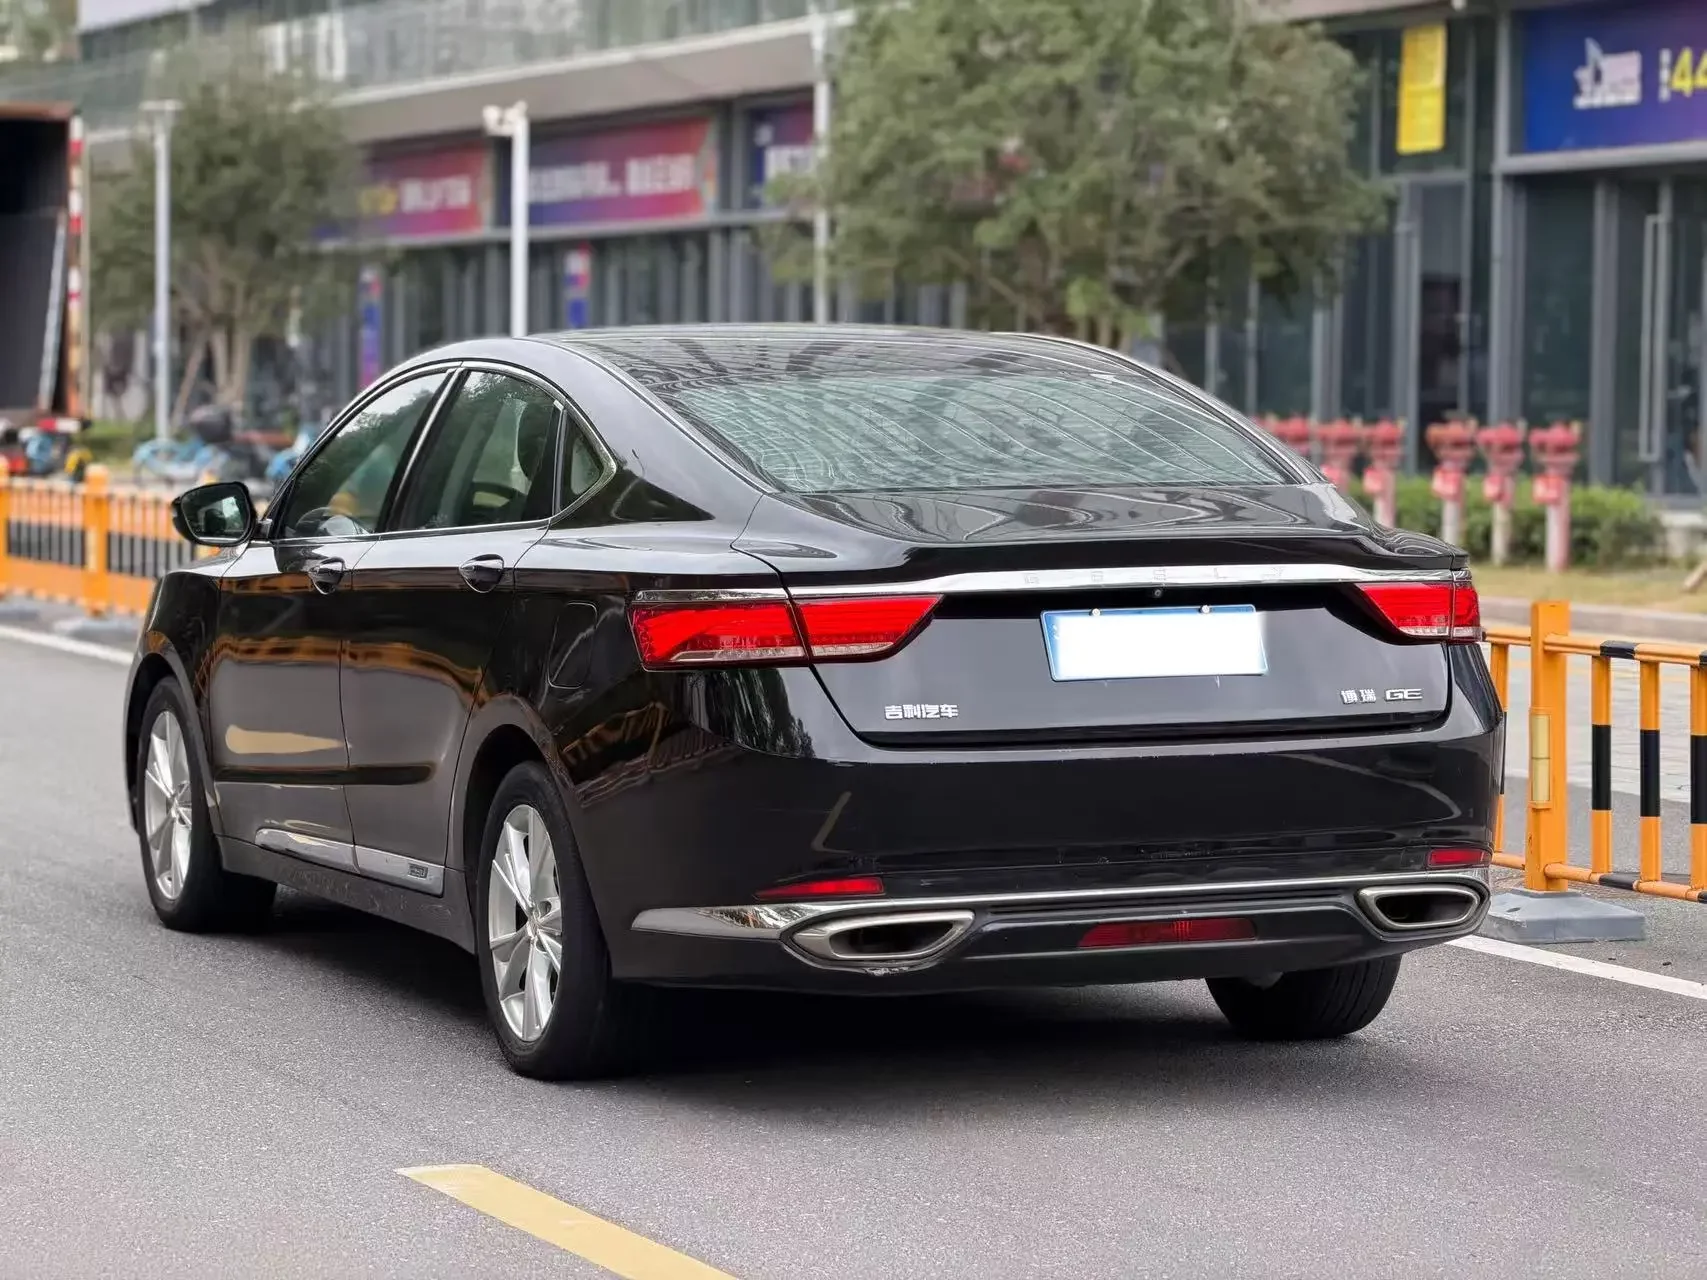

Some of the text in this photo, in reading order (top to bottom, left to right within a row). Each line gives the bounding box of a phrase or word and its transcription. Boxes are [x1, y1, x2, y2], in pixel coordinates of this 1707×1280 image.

[1341, 688, 1423, 704] 博瑞 GE
[884, 704, 959, 720] 吉利汽车
